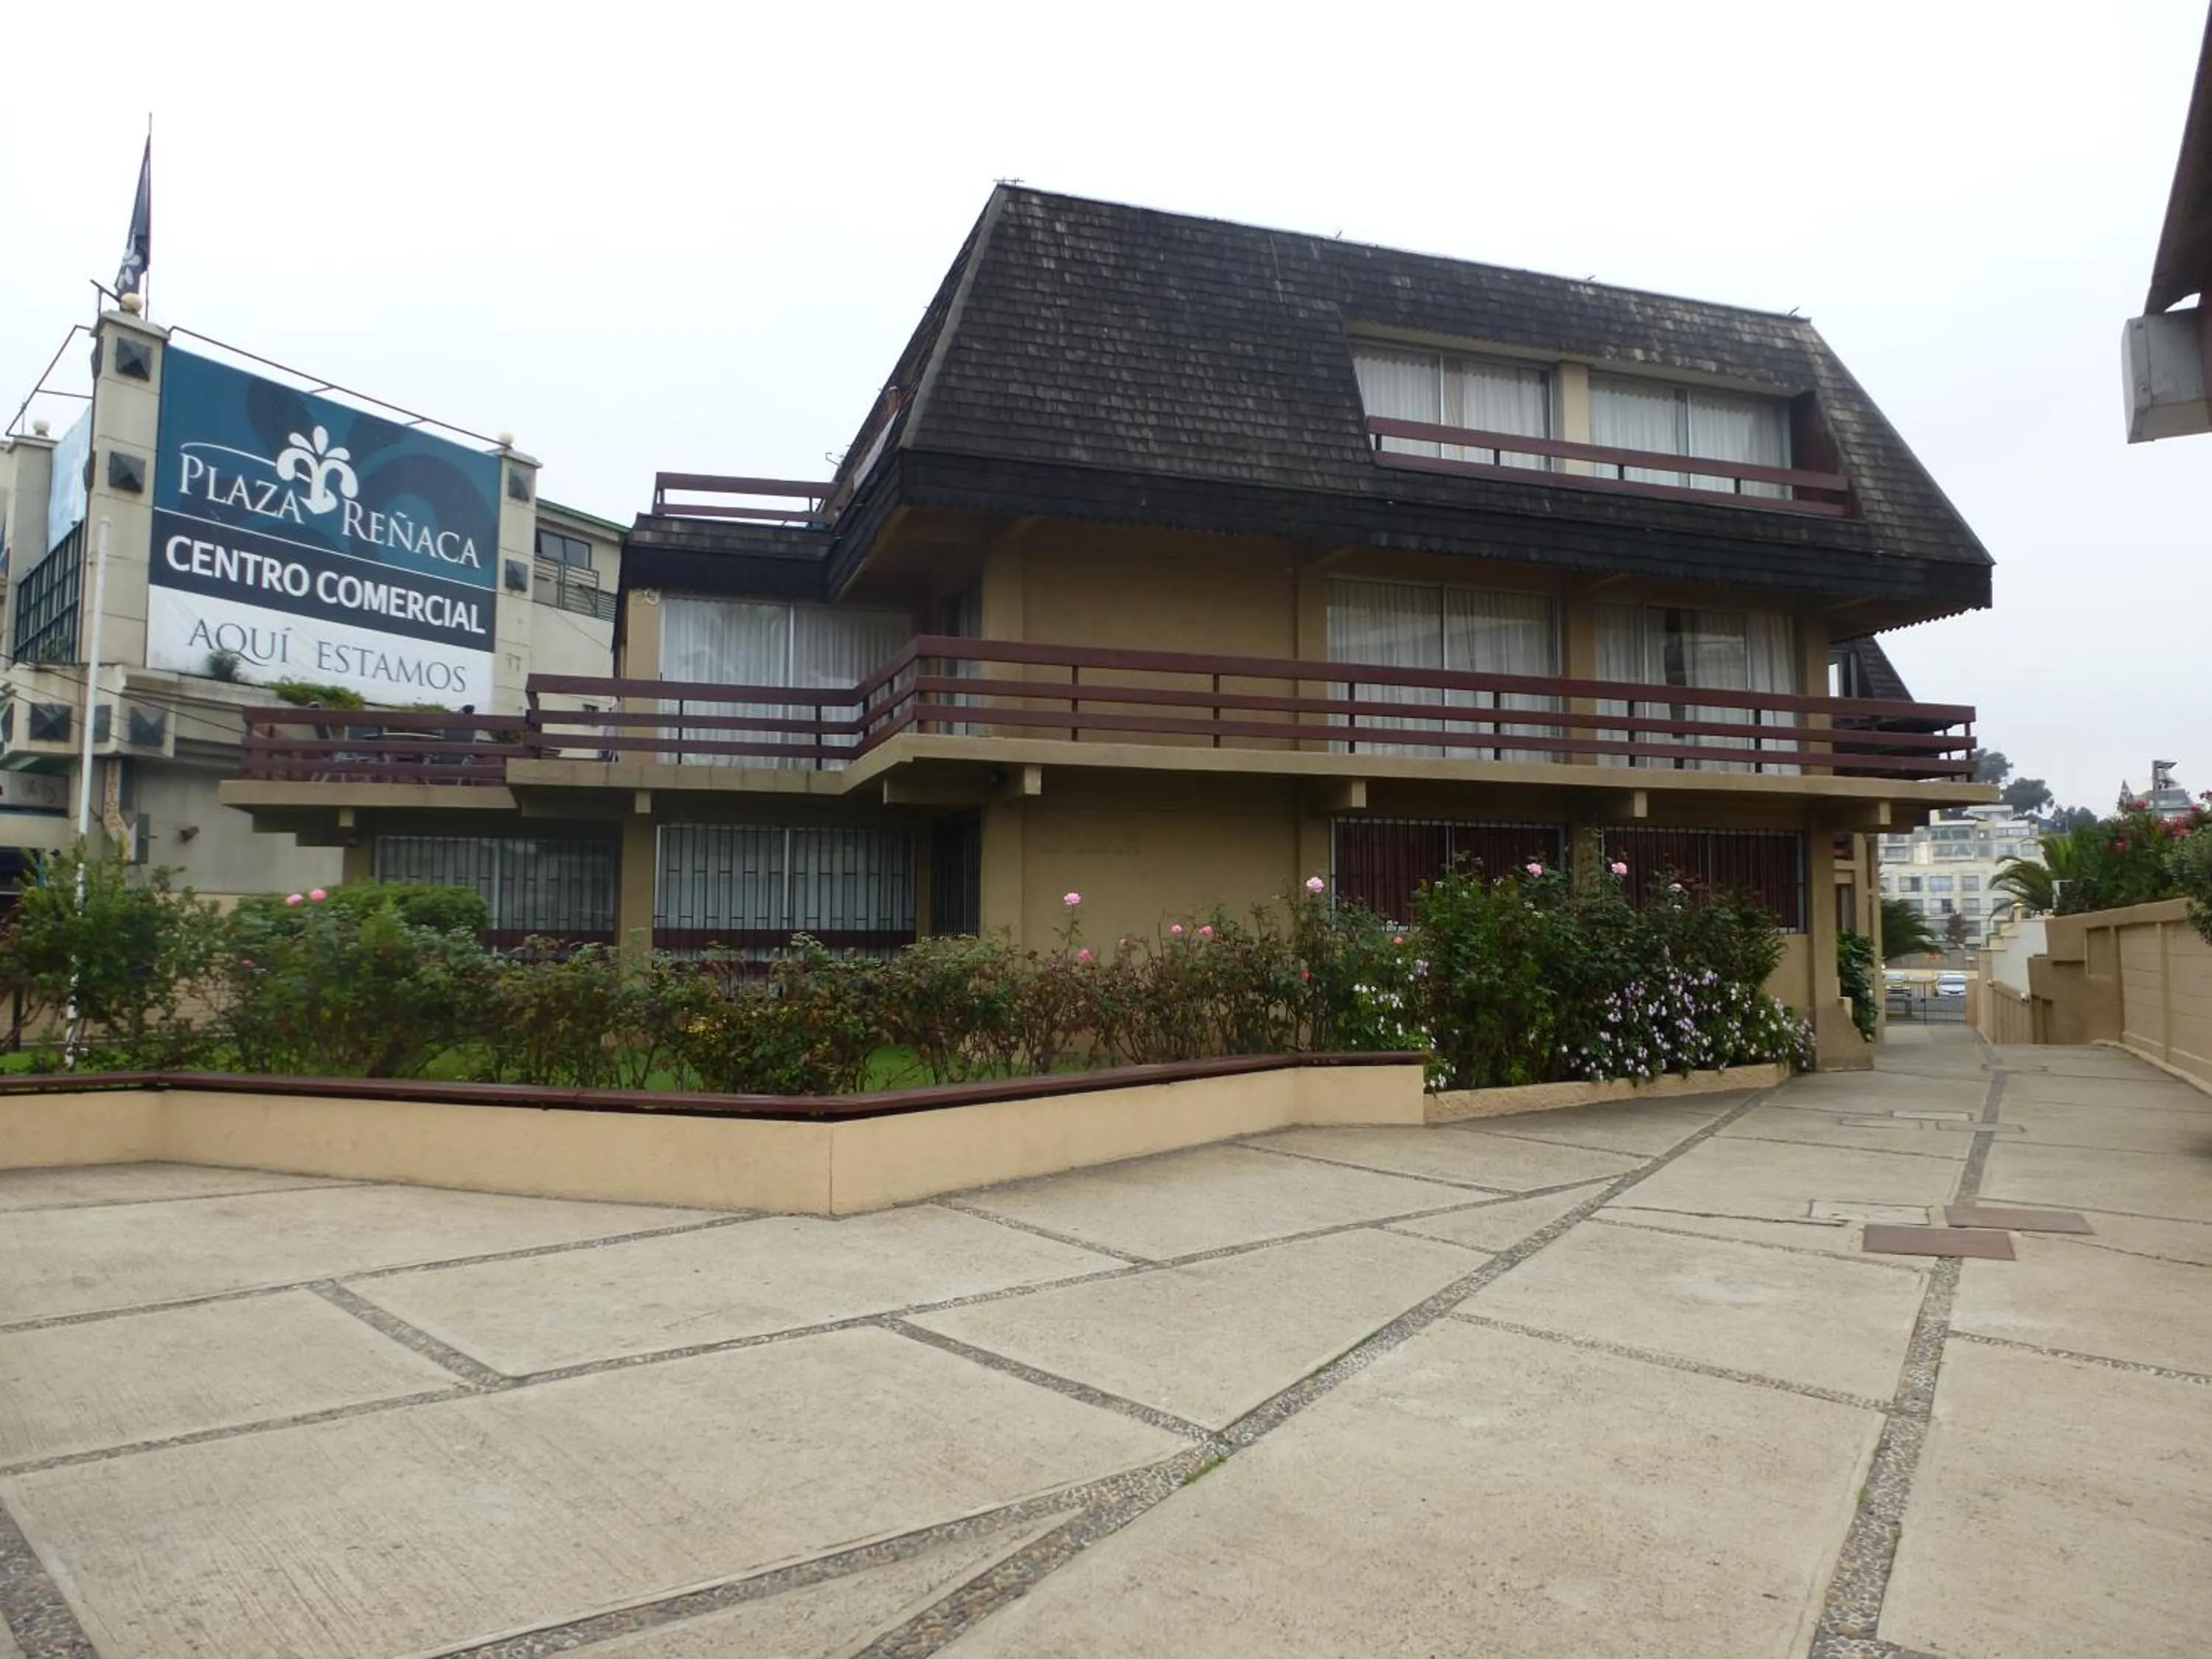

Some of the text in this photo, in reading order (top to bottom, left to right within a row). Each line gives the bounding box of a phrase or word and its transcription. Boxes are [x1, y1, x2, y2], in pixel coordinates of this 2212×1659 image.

[178, 452, 481, 568] PLAZA REÑACA
[166, 535, 487, 635] CENTRO COMERCIAL
[187, 618, 467, 693] AQUÍ ESTAMOS
